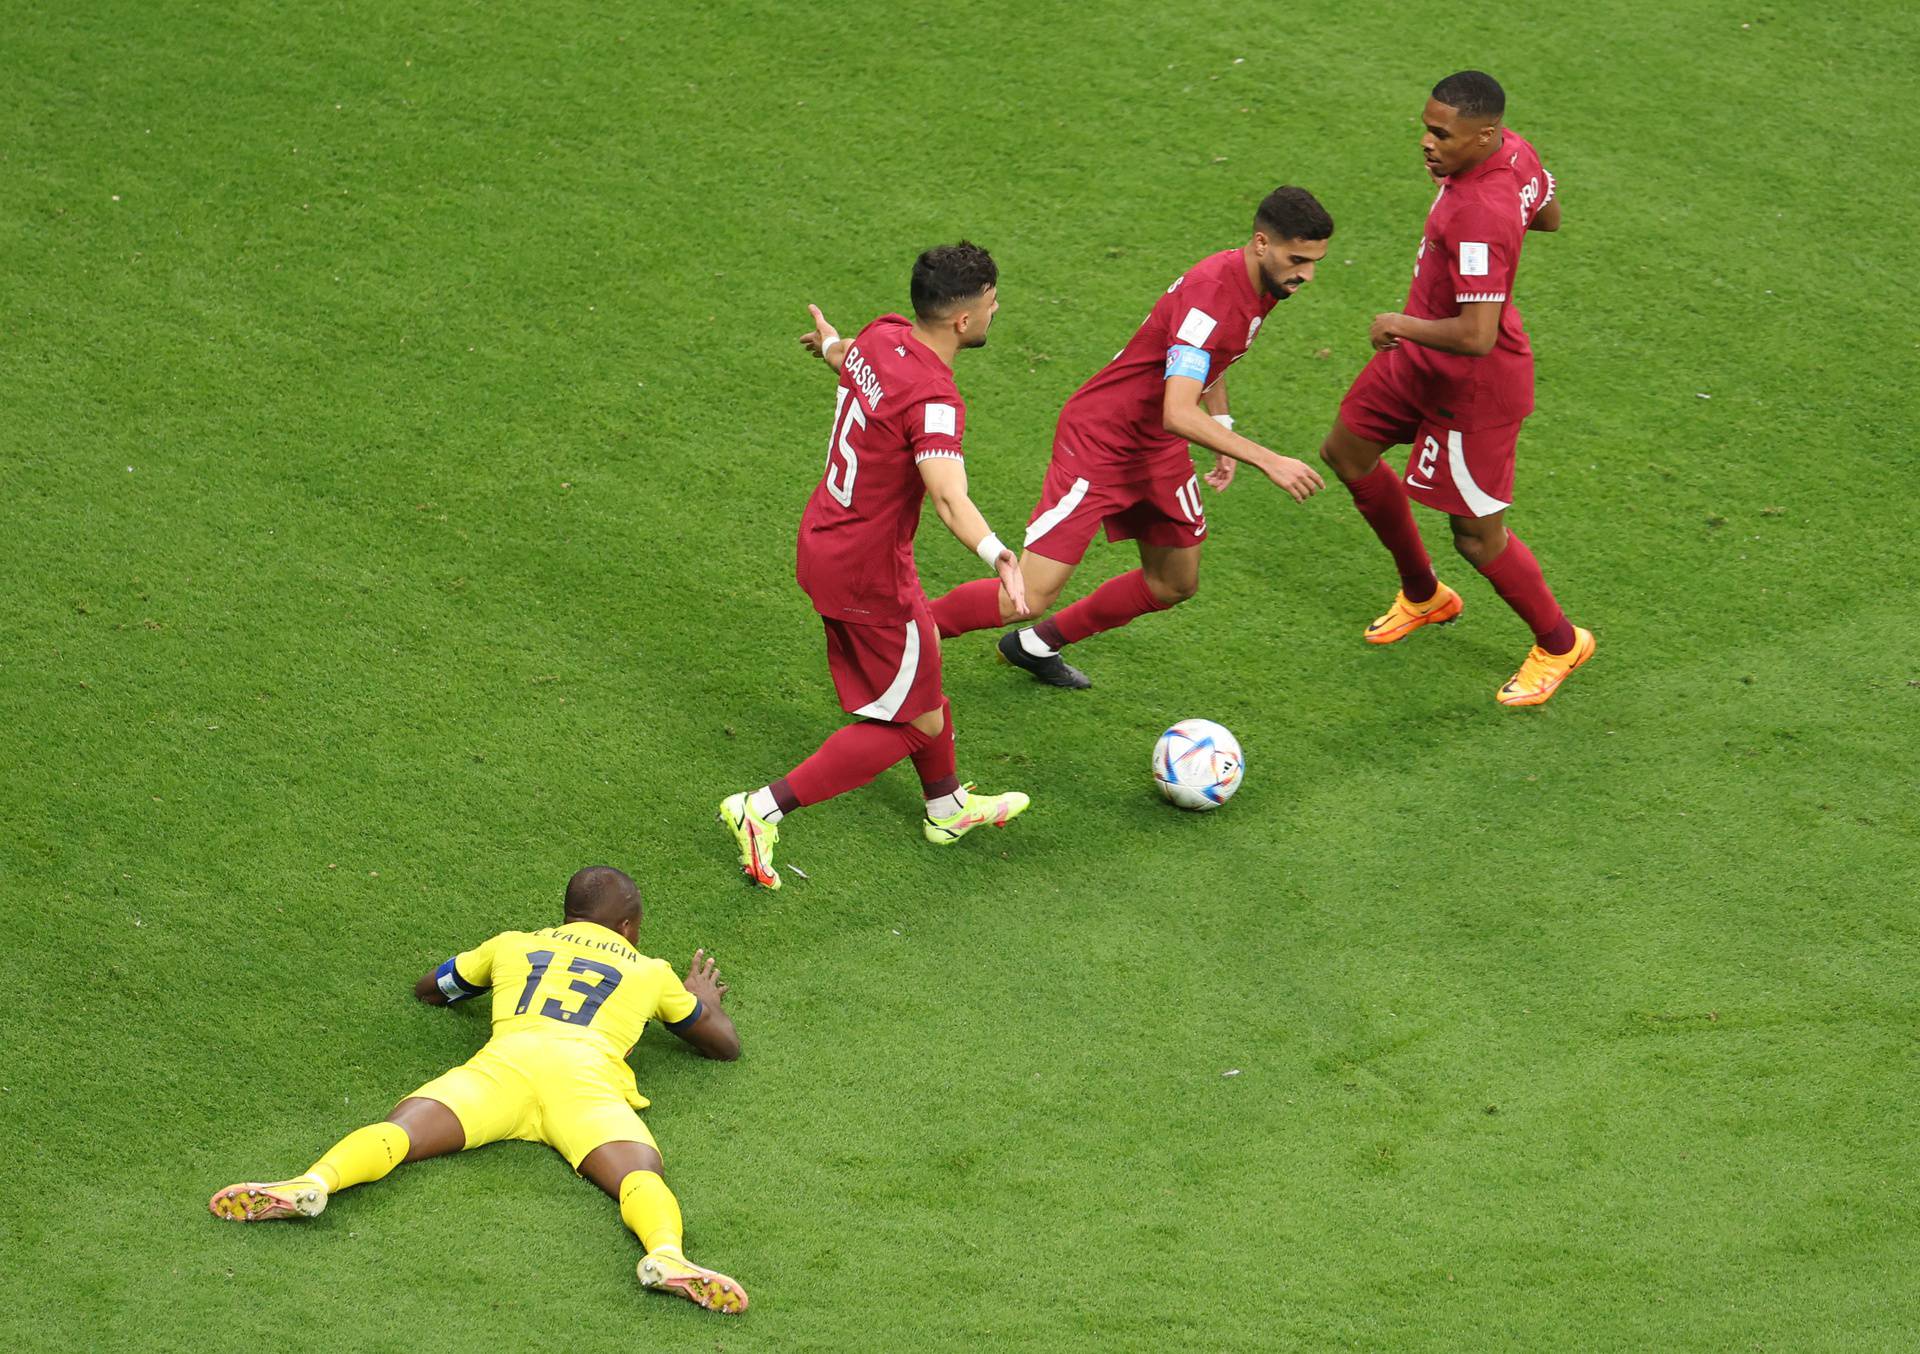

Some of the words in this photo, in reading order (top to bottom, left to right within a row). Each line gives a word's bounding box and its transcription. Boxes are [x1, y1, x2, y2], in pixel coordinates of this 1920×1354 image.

[825, 384, 867, 509] 15
[1417, 435, 1440, 480] 2
[1175, 473, 1204, 524] 10
[514, 949, 624, 1028] 13
